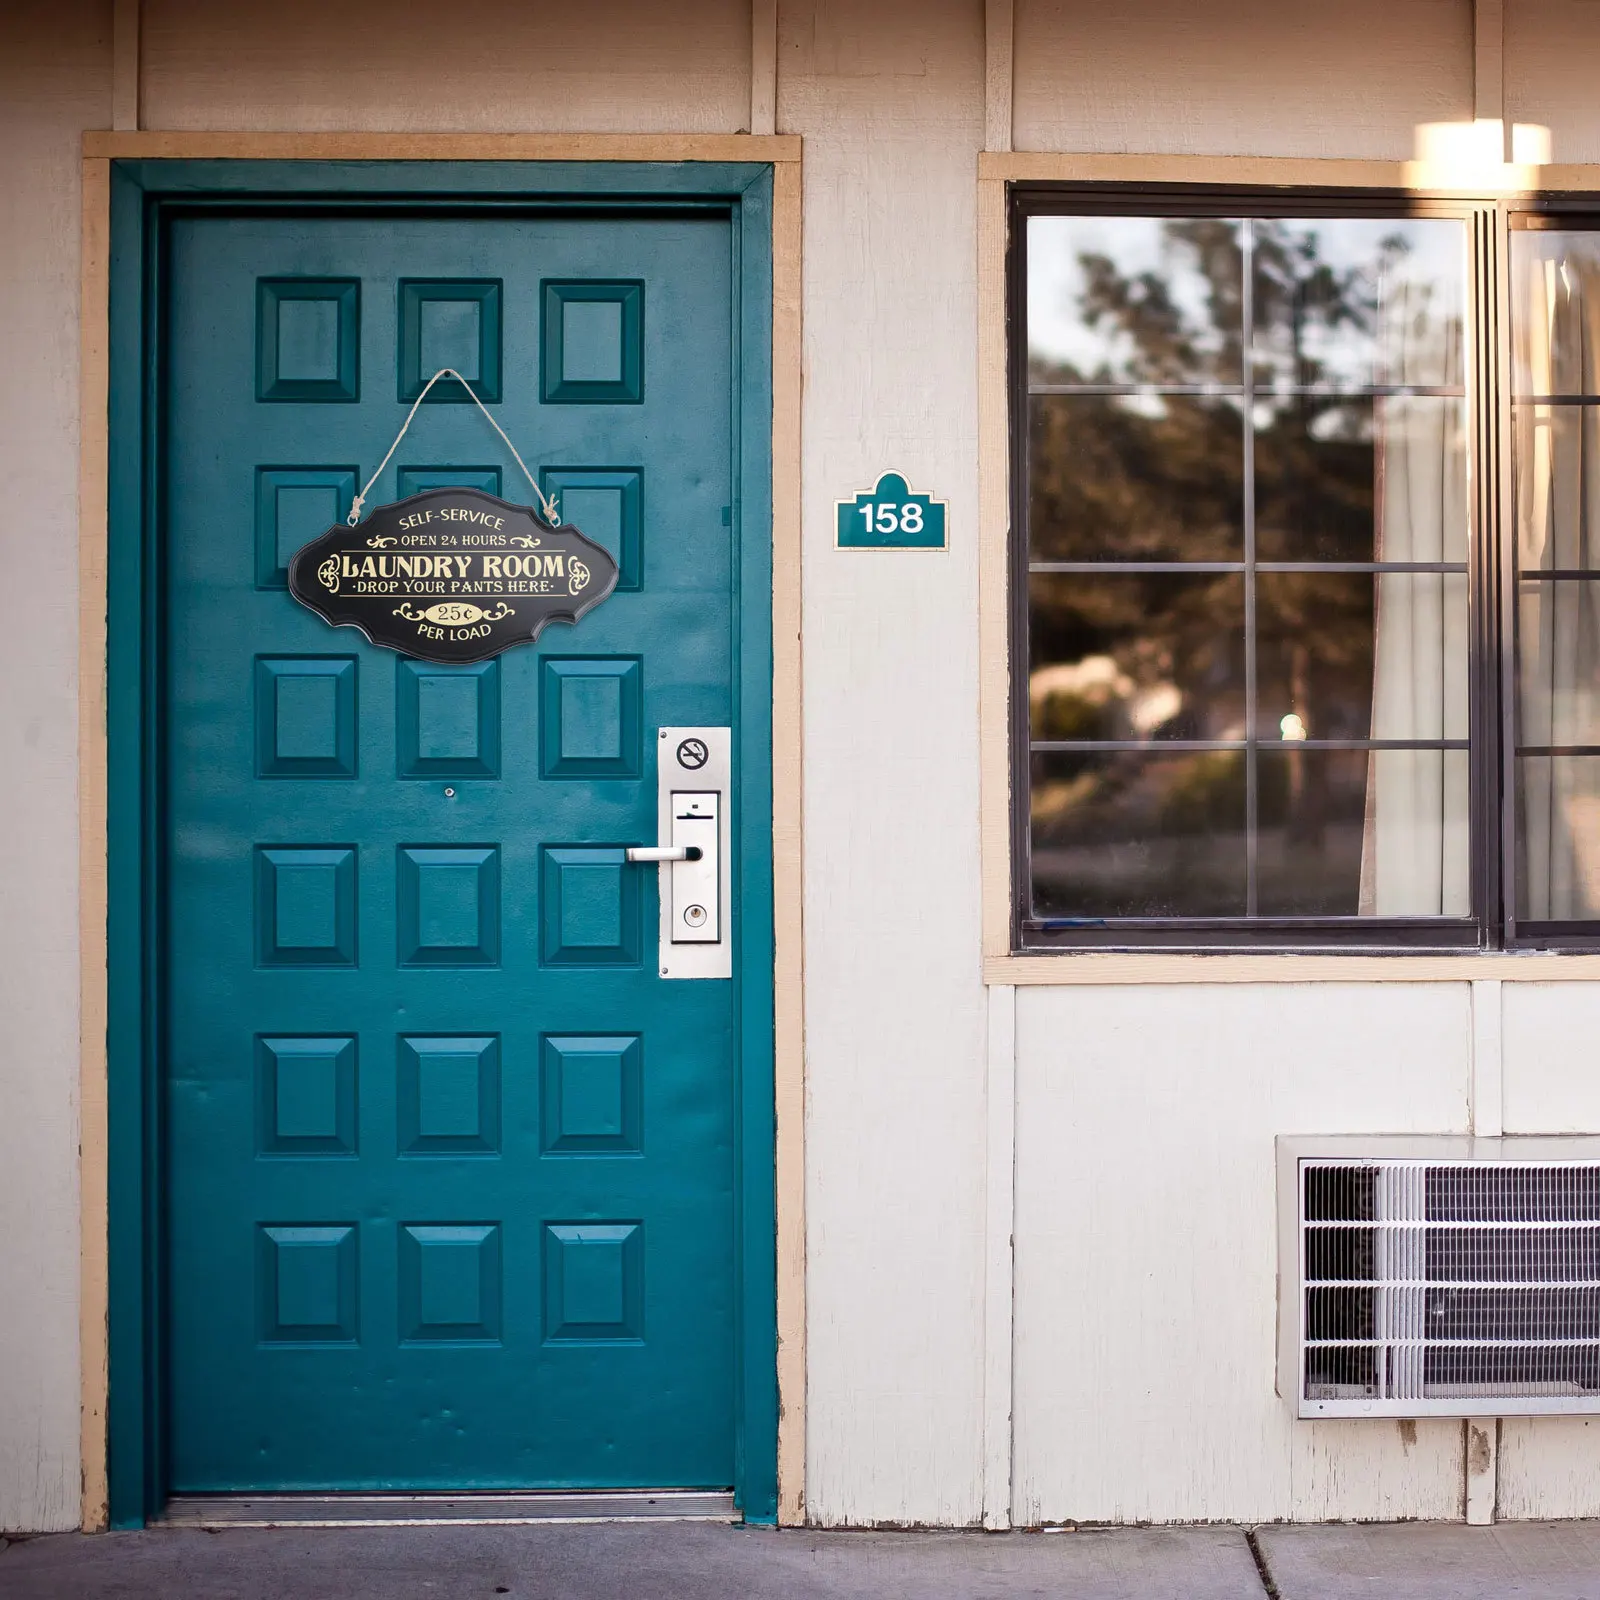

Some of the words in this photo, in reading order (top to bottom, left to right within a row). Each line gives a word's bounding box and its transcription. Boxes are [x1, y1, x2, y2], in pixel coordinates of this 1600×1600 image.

[398, 508, 505, 531] SELF-SERVICE
[858, 502, 924, 533] 158
[401, 535, 437, 546] OPEN
[441, 535, 458, 546] 24
[462, 535, 507, 546] HOURS
[342, 555, 472, 578] LAUNDRY
[482, 555, 564, 578] ROOM
[402, 579, 446, 593] YOUR
[450, 580, 503, 593] PANTS
[438, 606, 473, 621] 25¢
[417, 624, 444, 640] PER
[450, 624, 492, 641] LOAD
